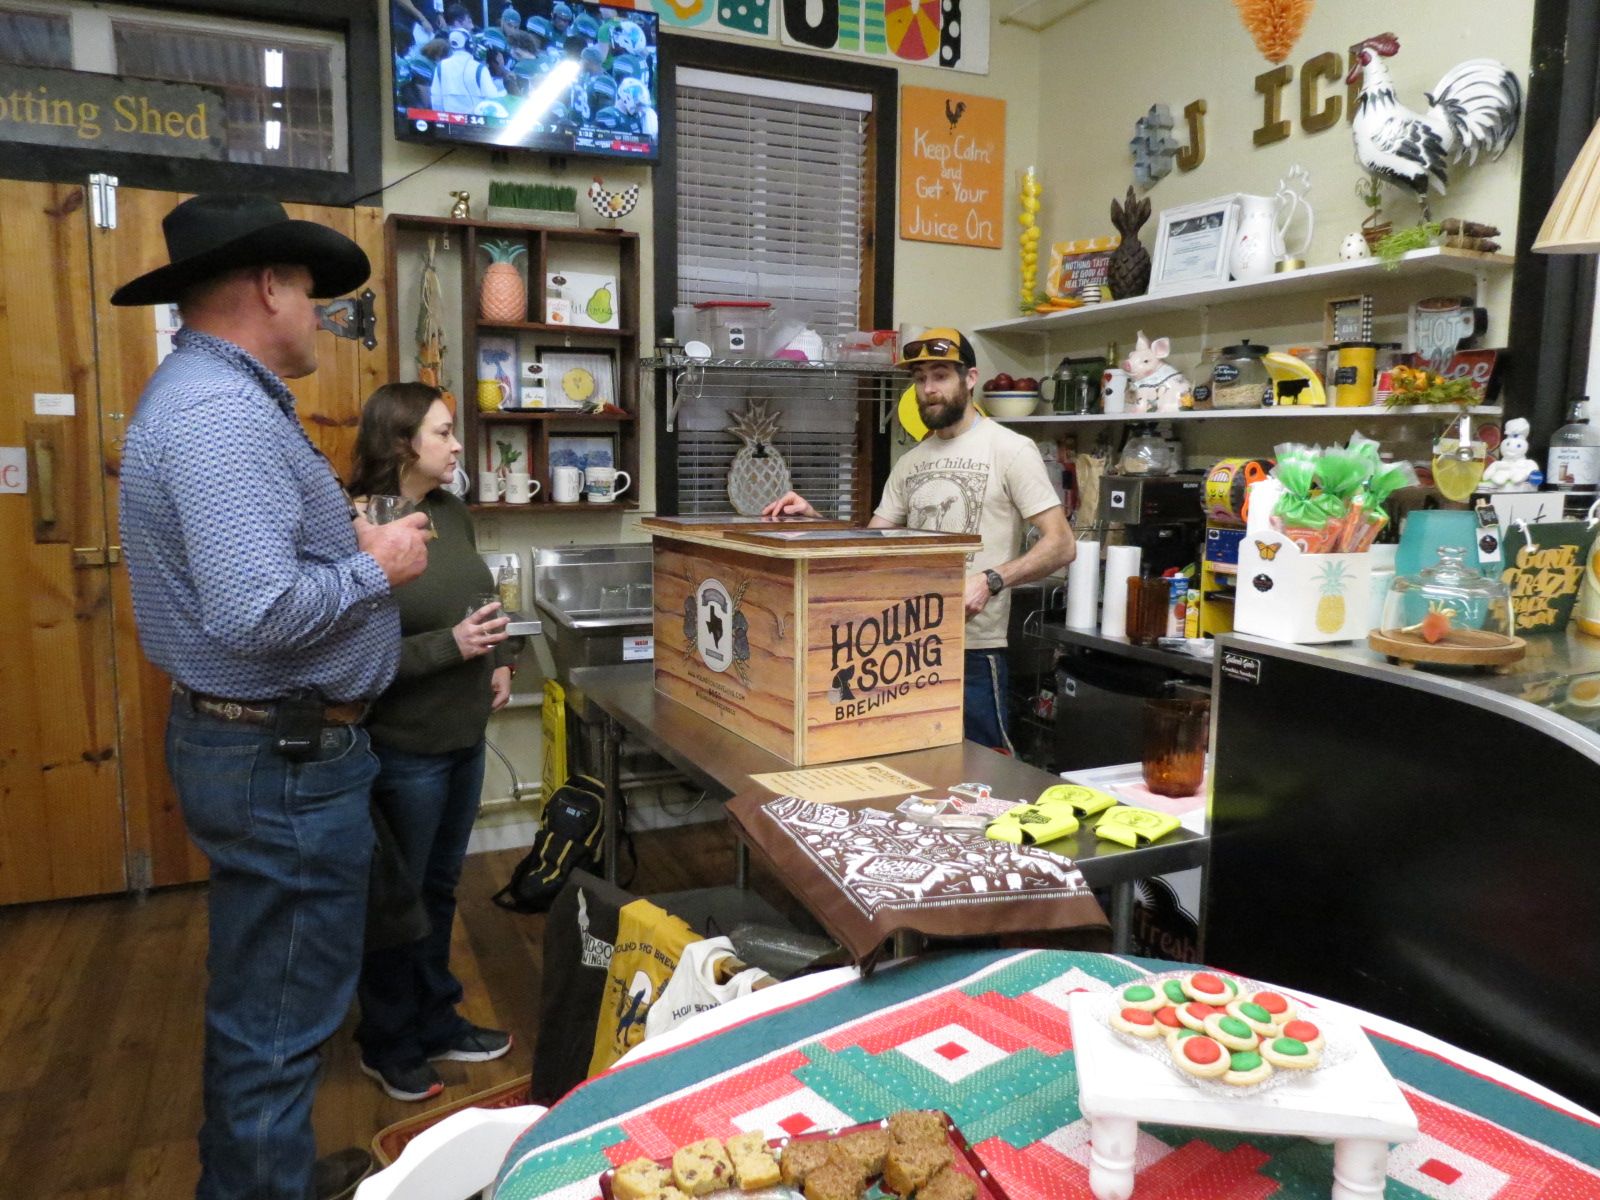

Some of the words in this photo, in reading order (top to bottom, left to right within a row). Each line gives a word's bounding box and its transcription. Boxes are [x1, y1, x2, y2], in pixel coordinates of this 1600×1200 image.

[114, 95, 209, 140] Shed
[914, 127, 951, 169] Keep
[953, 135, 991, 163] Calm
[916, 176, 943, 200] Get
[952, 182, 988, 203] Your
[941, 163, 963, 180] and
[909, 205, 958, 240] Juice
[966, 208, 993, 241] On
[1416, 316, 1461, 347] HOT
[936, 456, 991, 471] Childers
[830, 592, 944, 672] HOUND
[857, 634, 943, 692] SONG
[835, 681, 910, 721] BREWING
[916, 672, 943, 689] CO.
